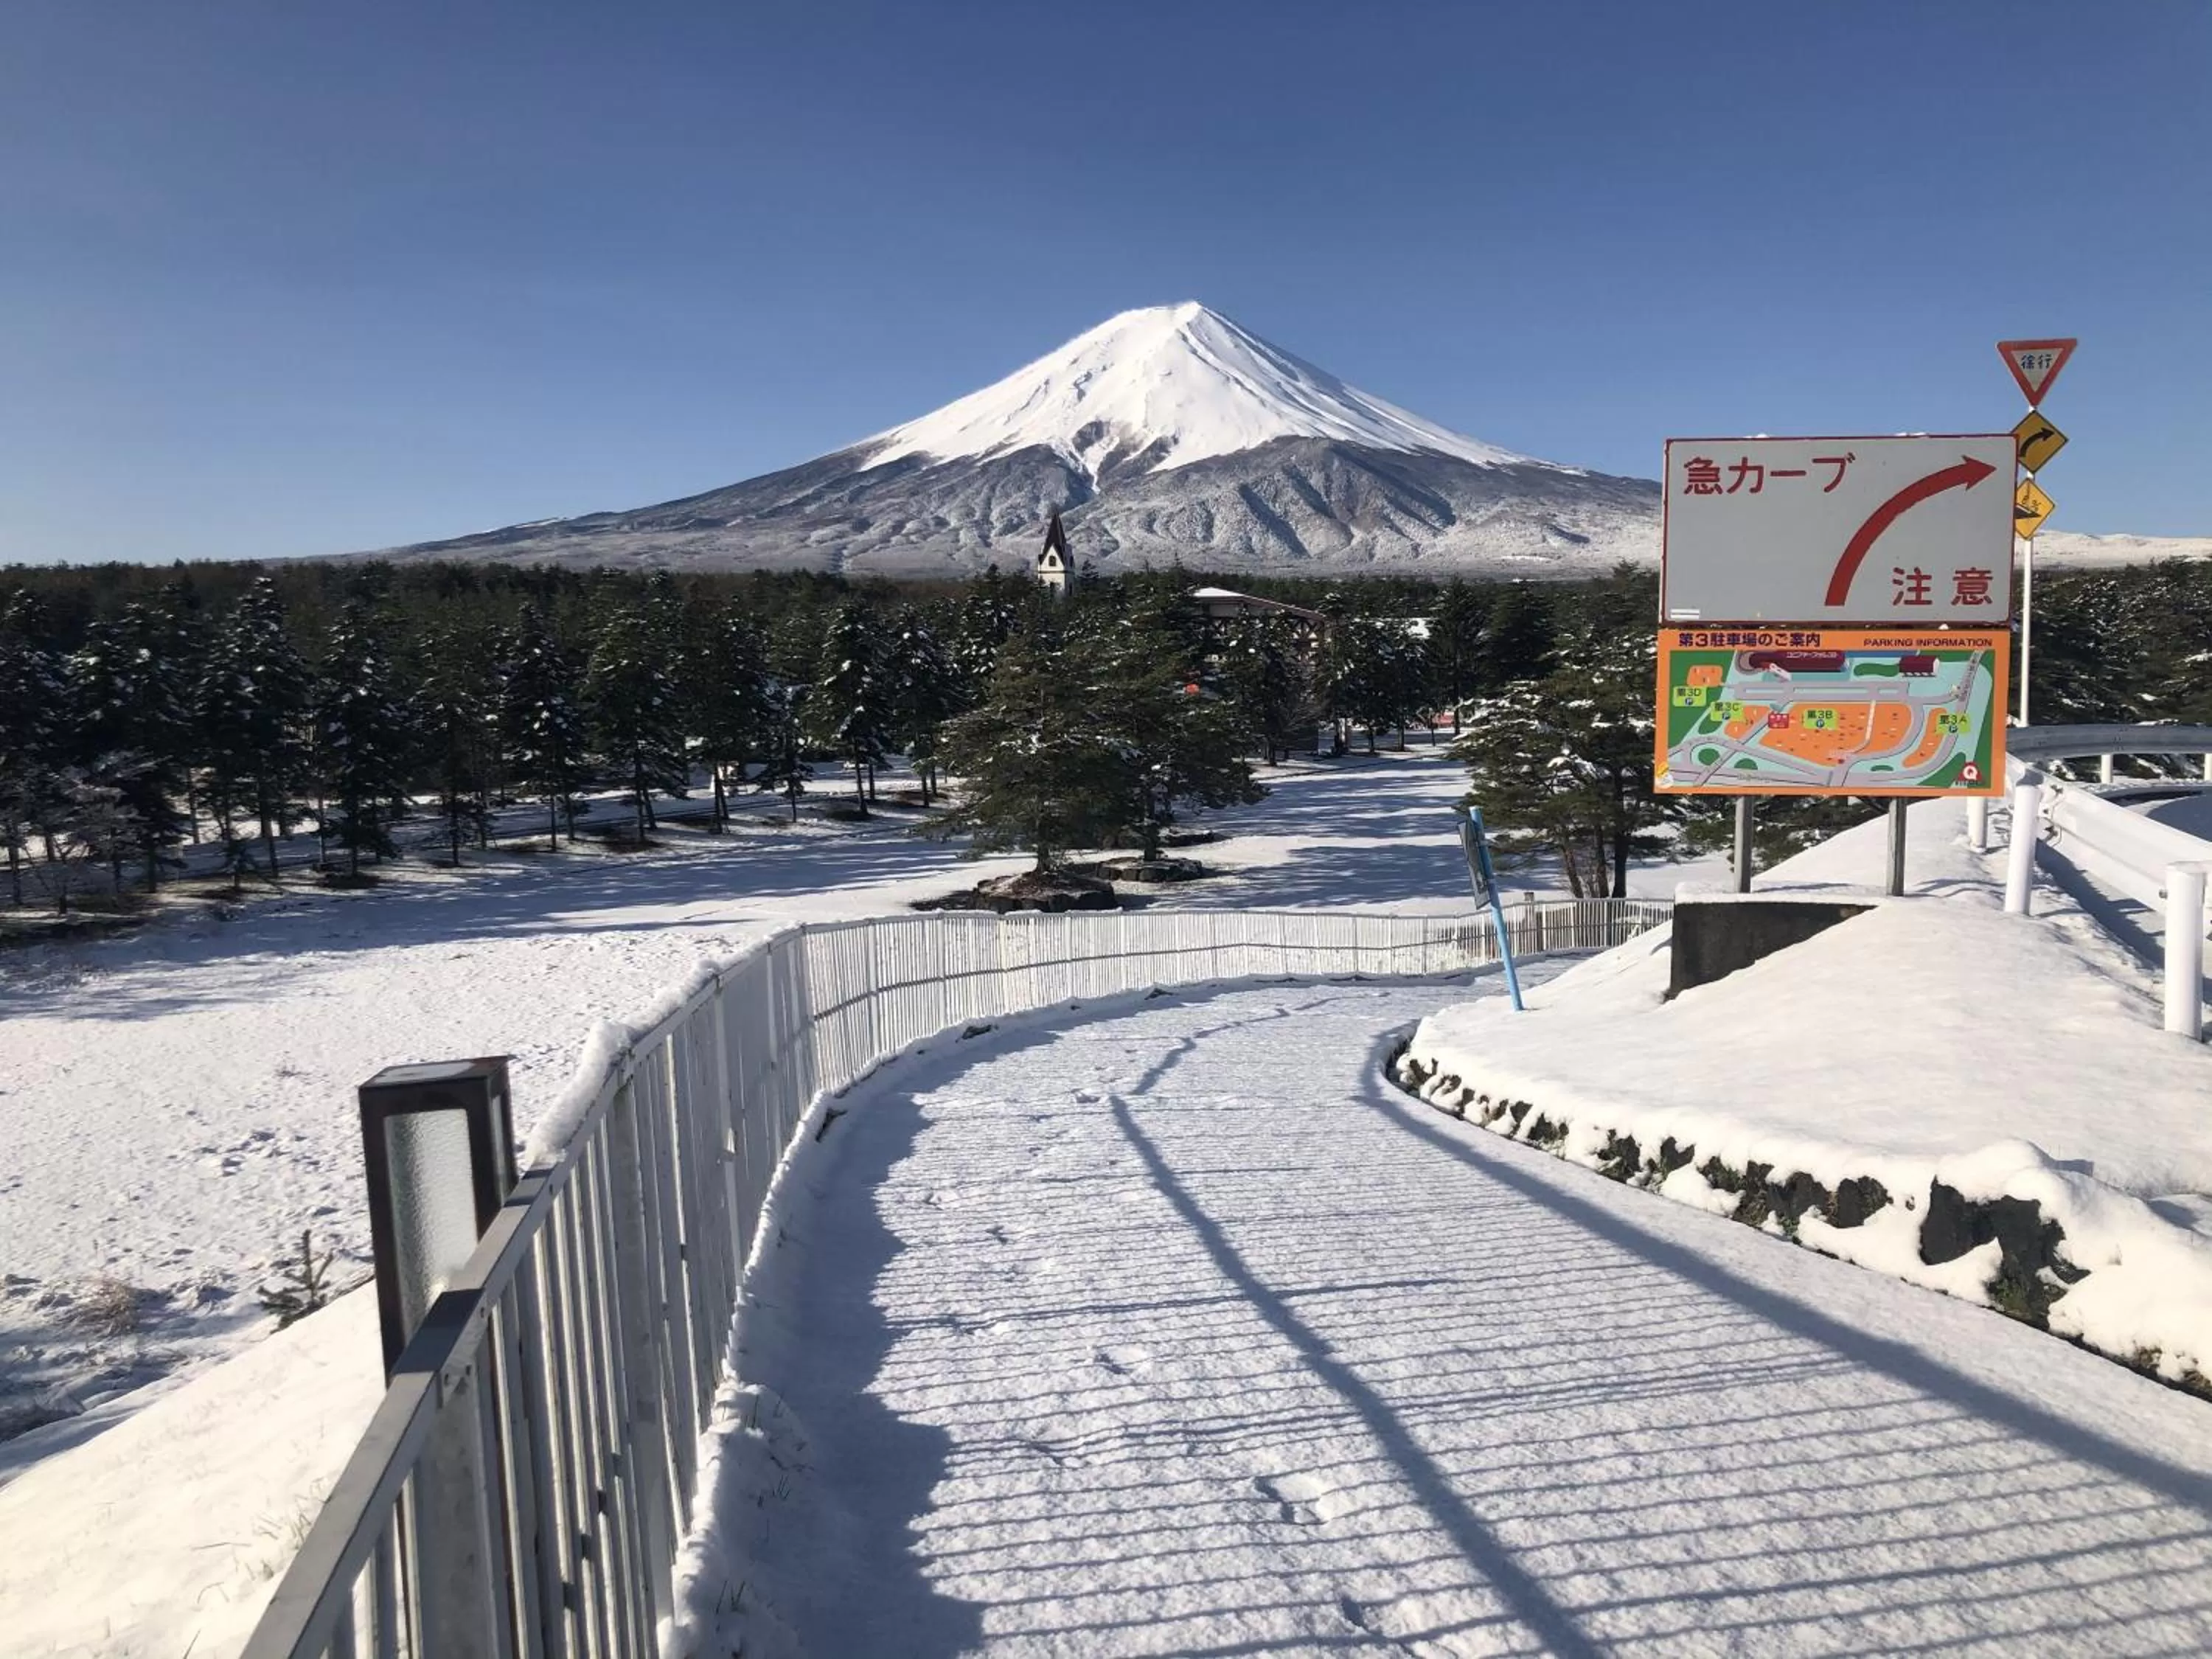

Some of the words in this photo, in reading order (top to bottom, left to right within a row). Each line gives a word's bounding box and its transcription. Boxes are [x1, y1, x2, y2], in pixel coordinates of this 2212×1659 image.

[2021, 354, 2053, 369] 徐行
[1683, 452, 1856, 495] 急カーブ
[1678, 633, 1820, 647] 第3駐車場のご案内
[1864, 639, 1913, 647] PARKING
[1916, 639, 1992, 647] INFORMATION
